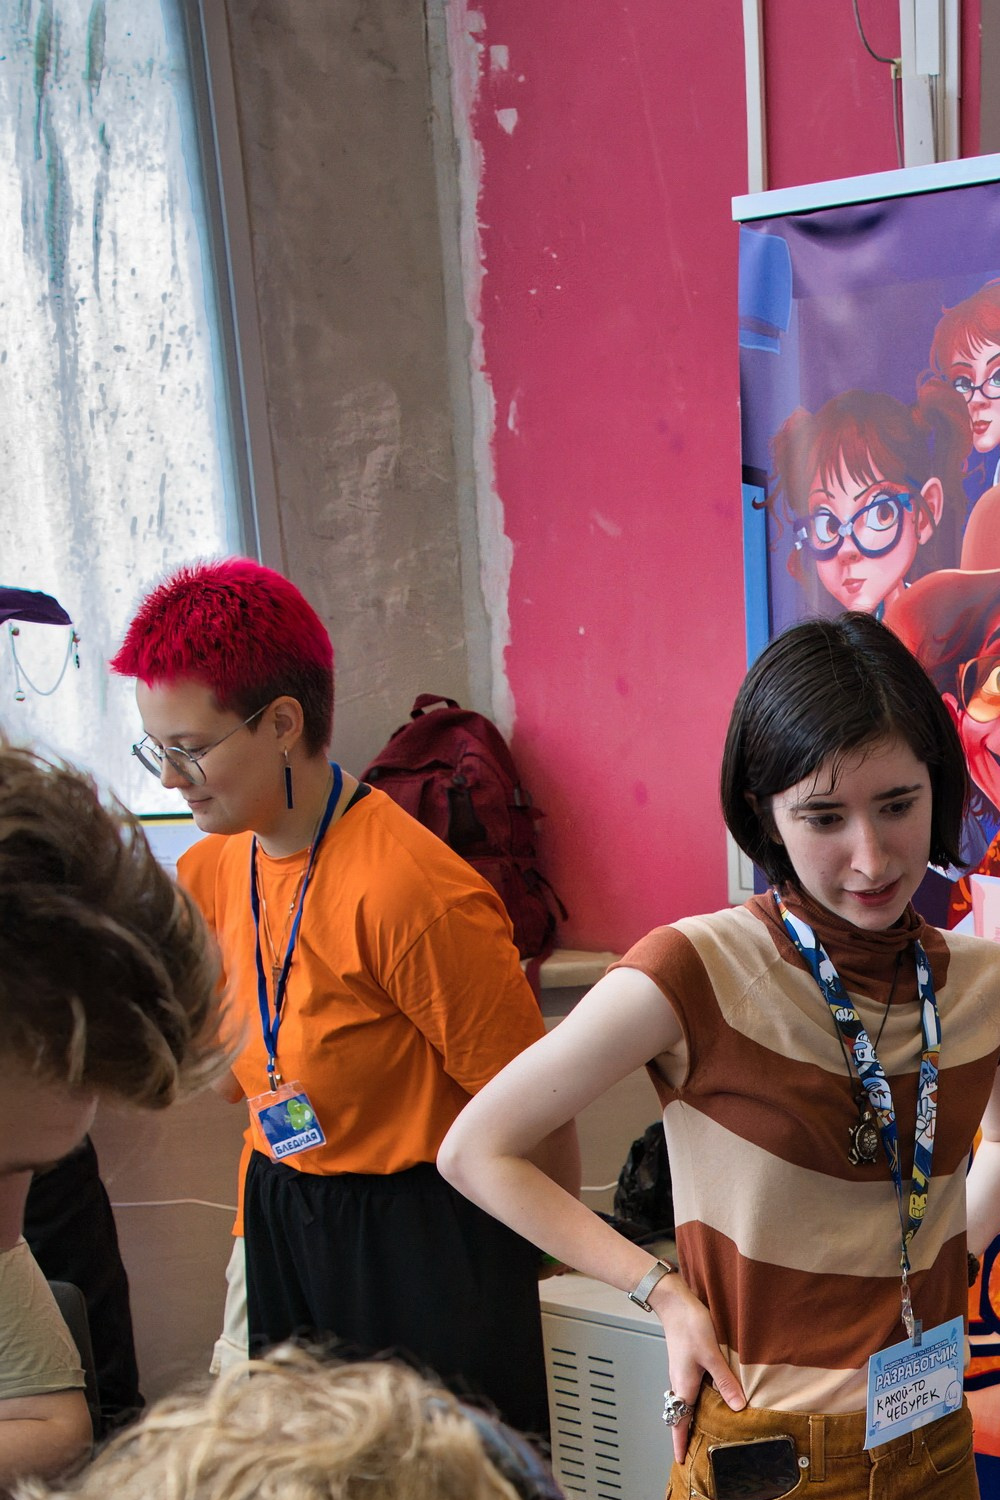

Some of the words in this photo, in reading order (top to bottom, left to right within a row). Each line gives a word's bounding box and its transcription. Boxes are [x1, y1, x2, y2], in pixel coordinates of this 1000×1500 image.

[274, 1131, 318, 1155] БЛЕДНАЯ
[875, 1342, 957, 1391] РАЗРАБОТЧИК
[877, 1379, 926, 1416] КАКОЙ-ТО
[886, 1388, 941, 1422] ЧЕБУРЕК
